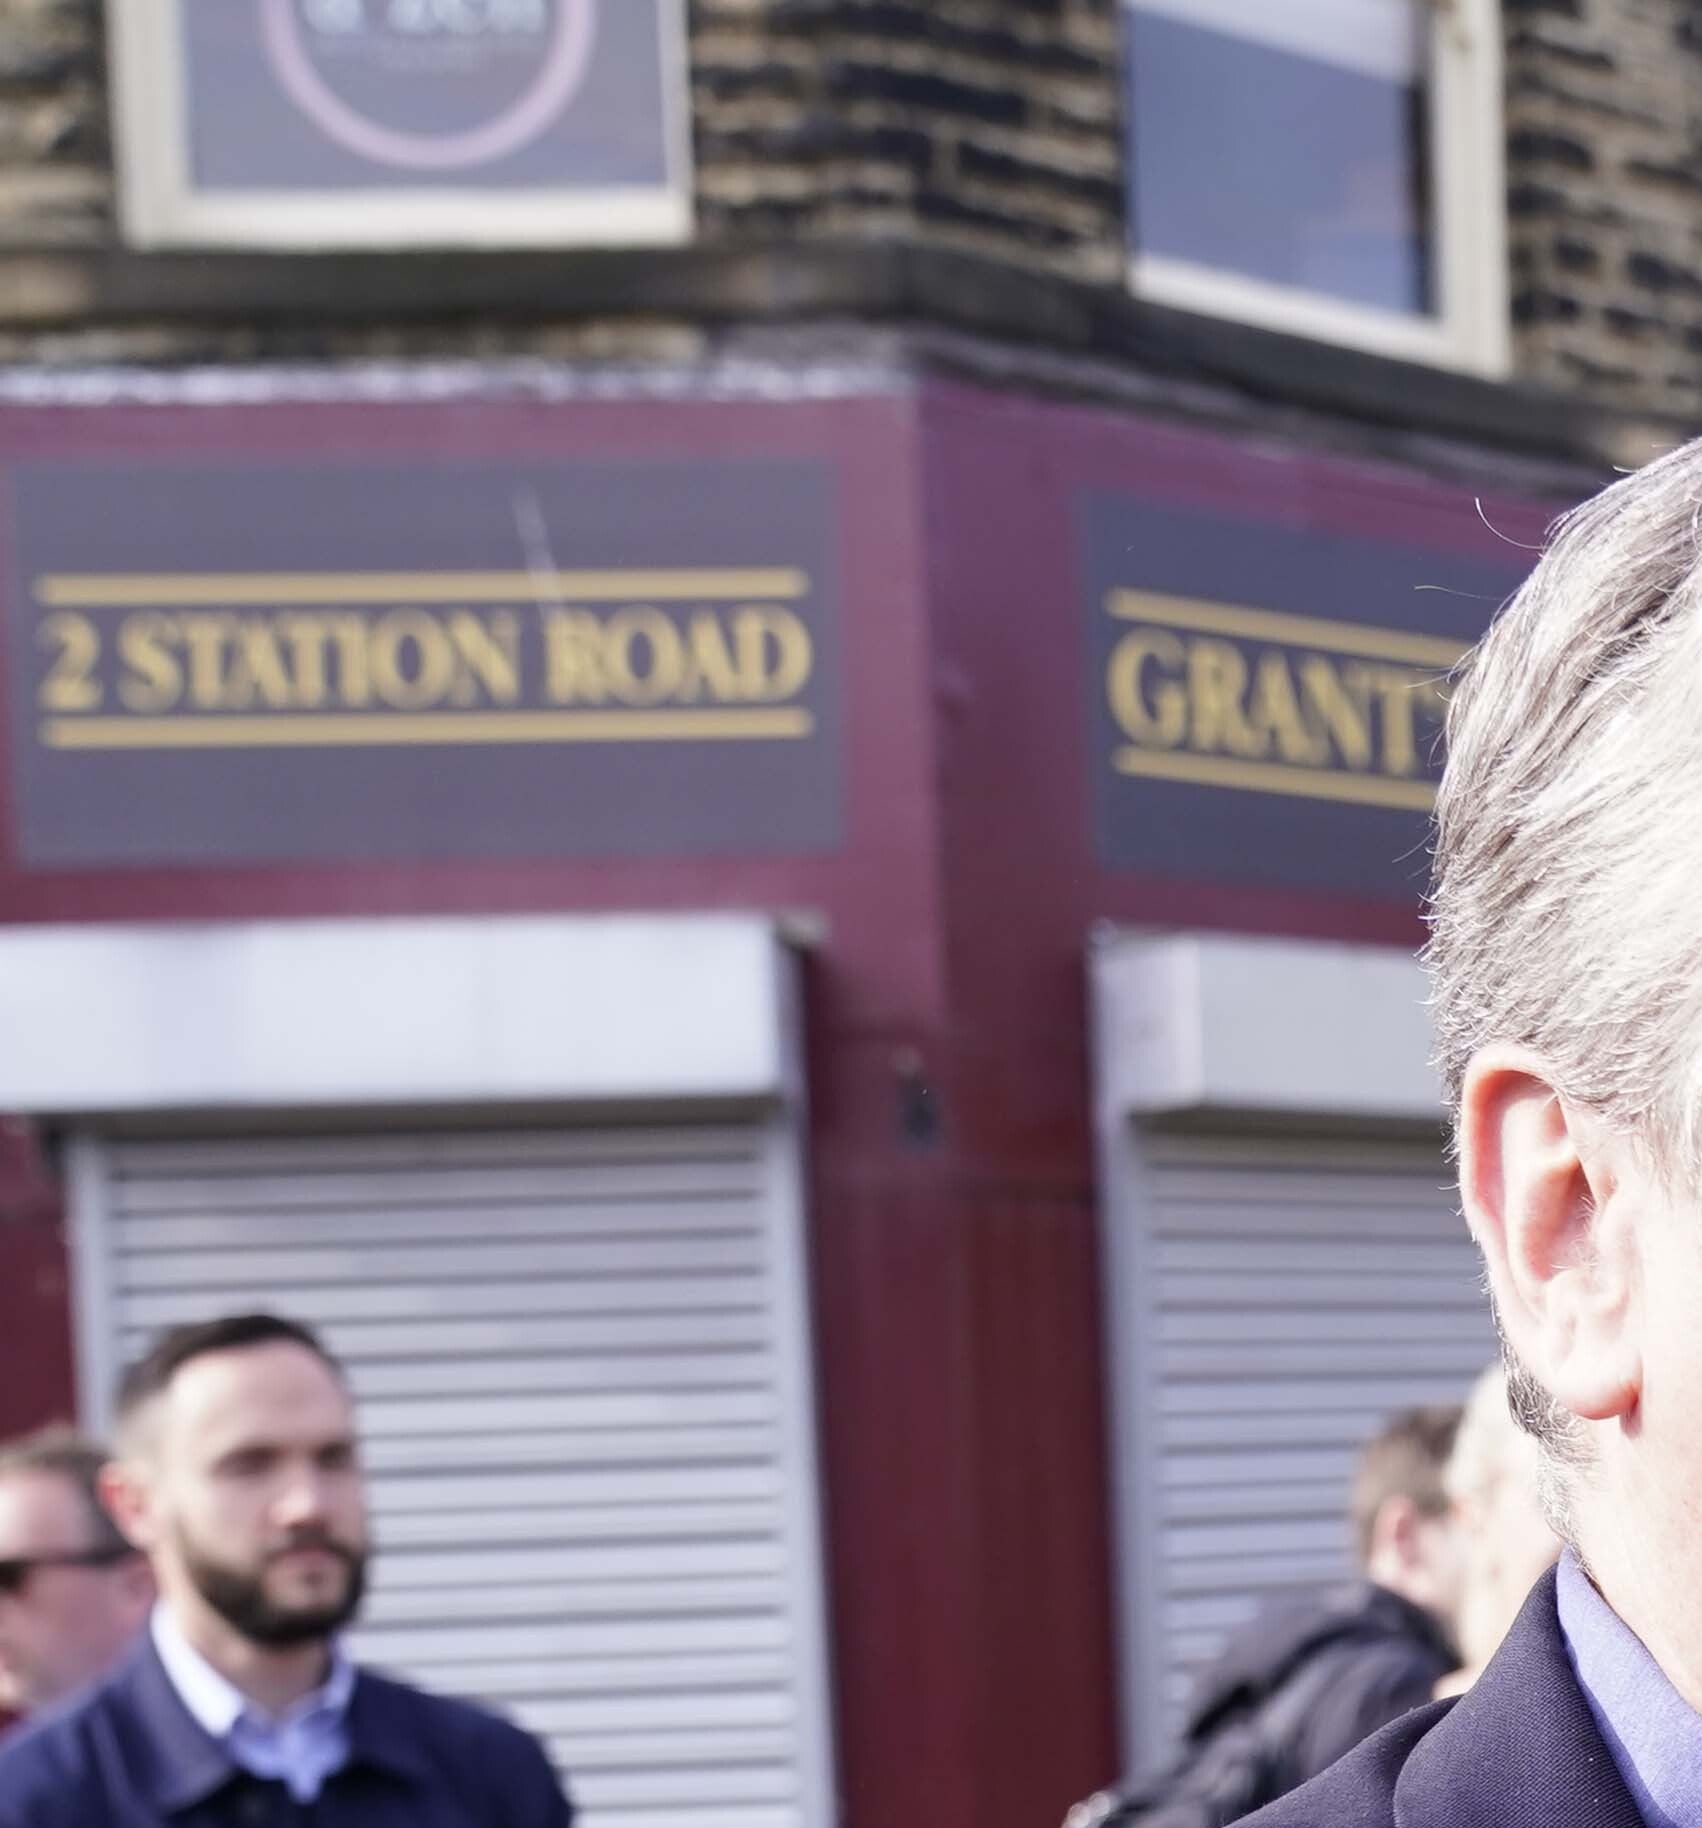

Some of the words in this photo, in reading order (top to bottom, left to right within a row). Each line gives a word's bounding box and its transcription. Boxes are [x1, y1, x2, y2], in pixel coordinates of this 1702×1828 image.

[38, 611, 102, 711] 2
[117, 607, 518, 714] STATION
[545, 604, 814, 705] ROAD
